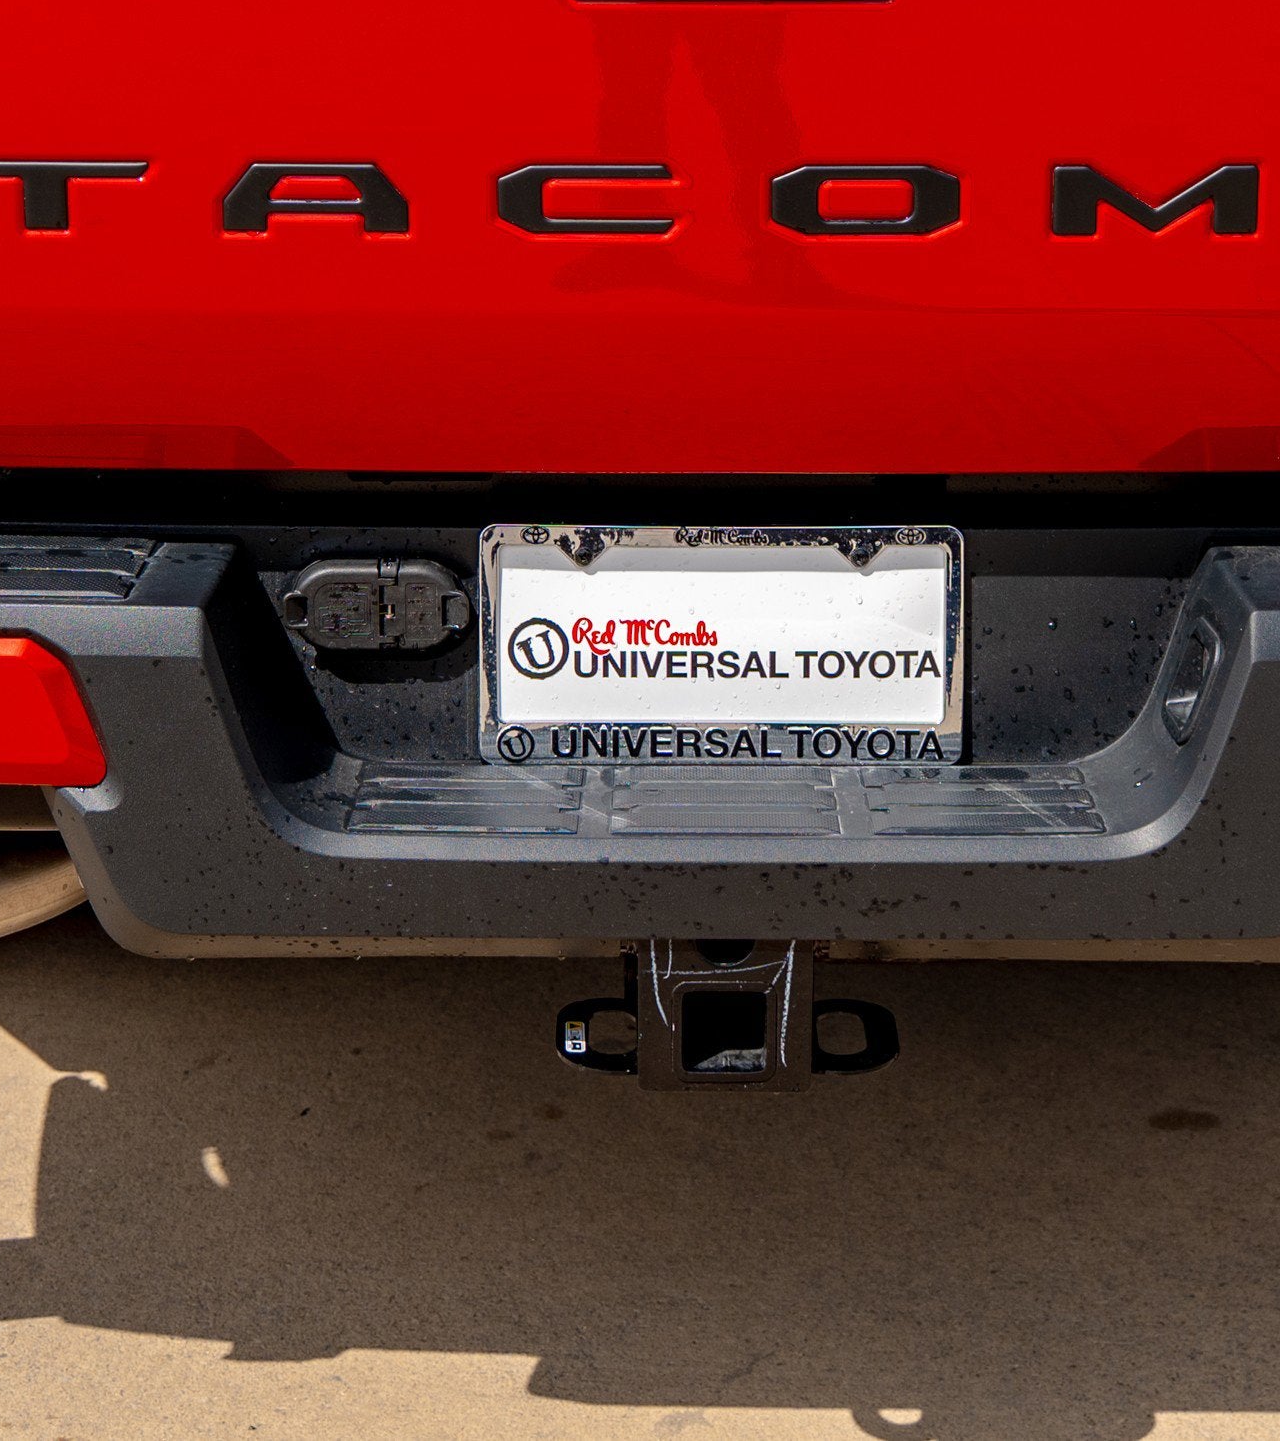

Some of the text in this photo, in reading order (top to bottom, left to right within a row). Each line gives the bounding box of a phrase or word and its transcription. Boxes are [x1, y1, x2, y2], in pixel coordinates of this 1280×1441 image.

[571, 617, 718, 656] Red McCombs
[573, 650, 942, 679] UNIVERSAL TOYOTA
[550, 726, 944, 759] UNIVERSAL TOYOTA
